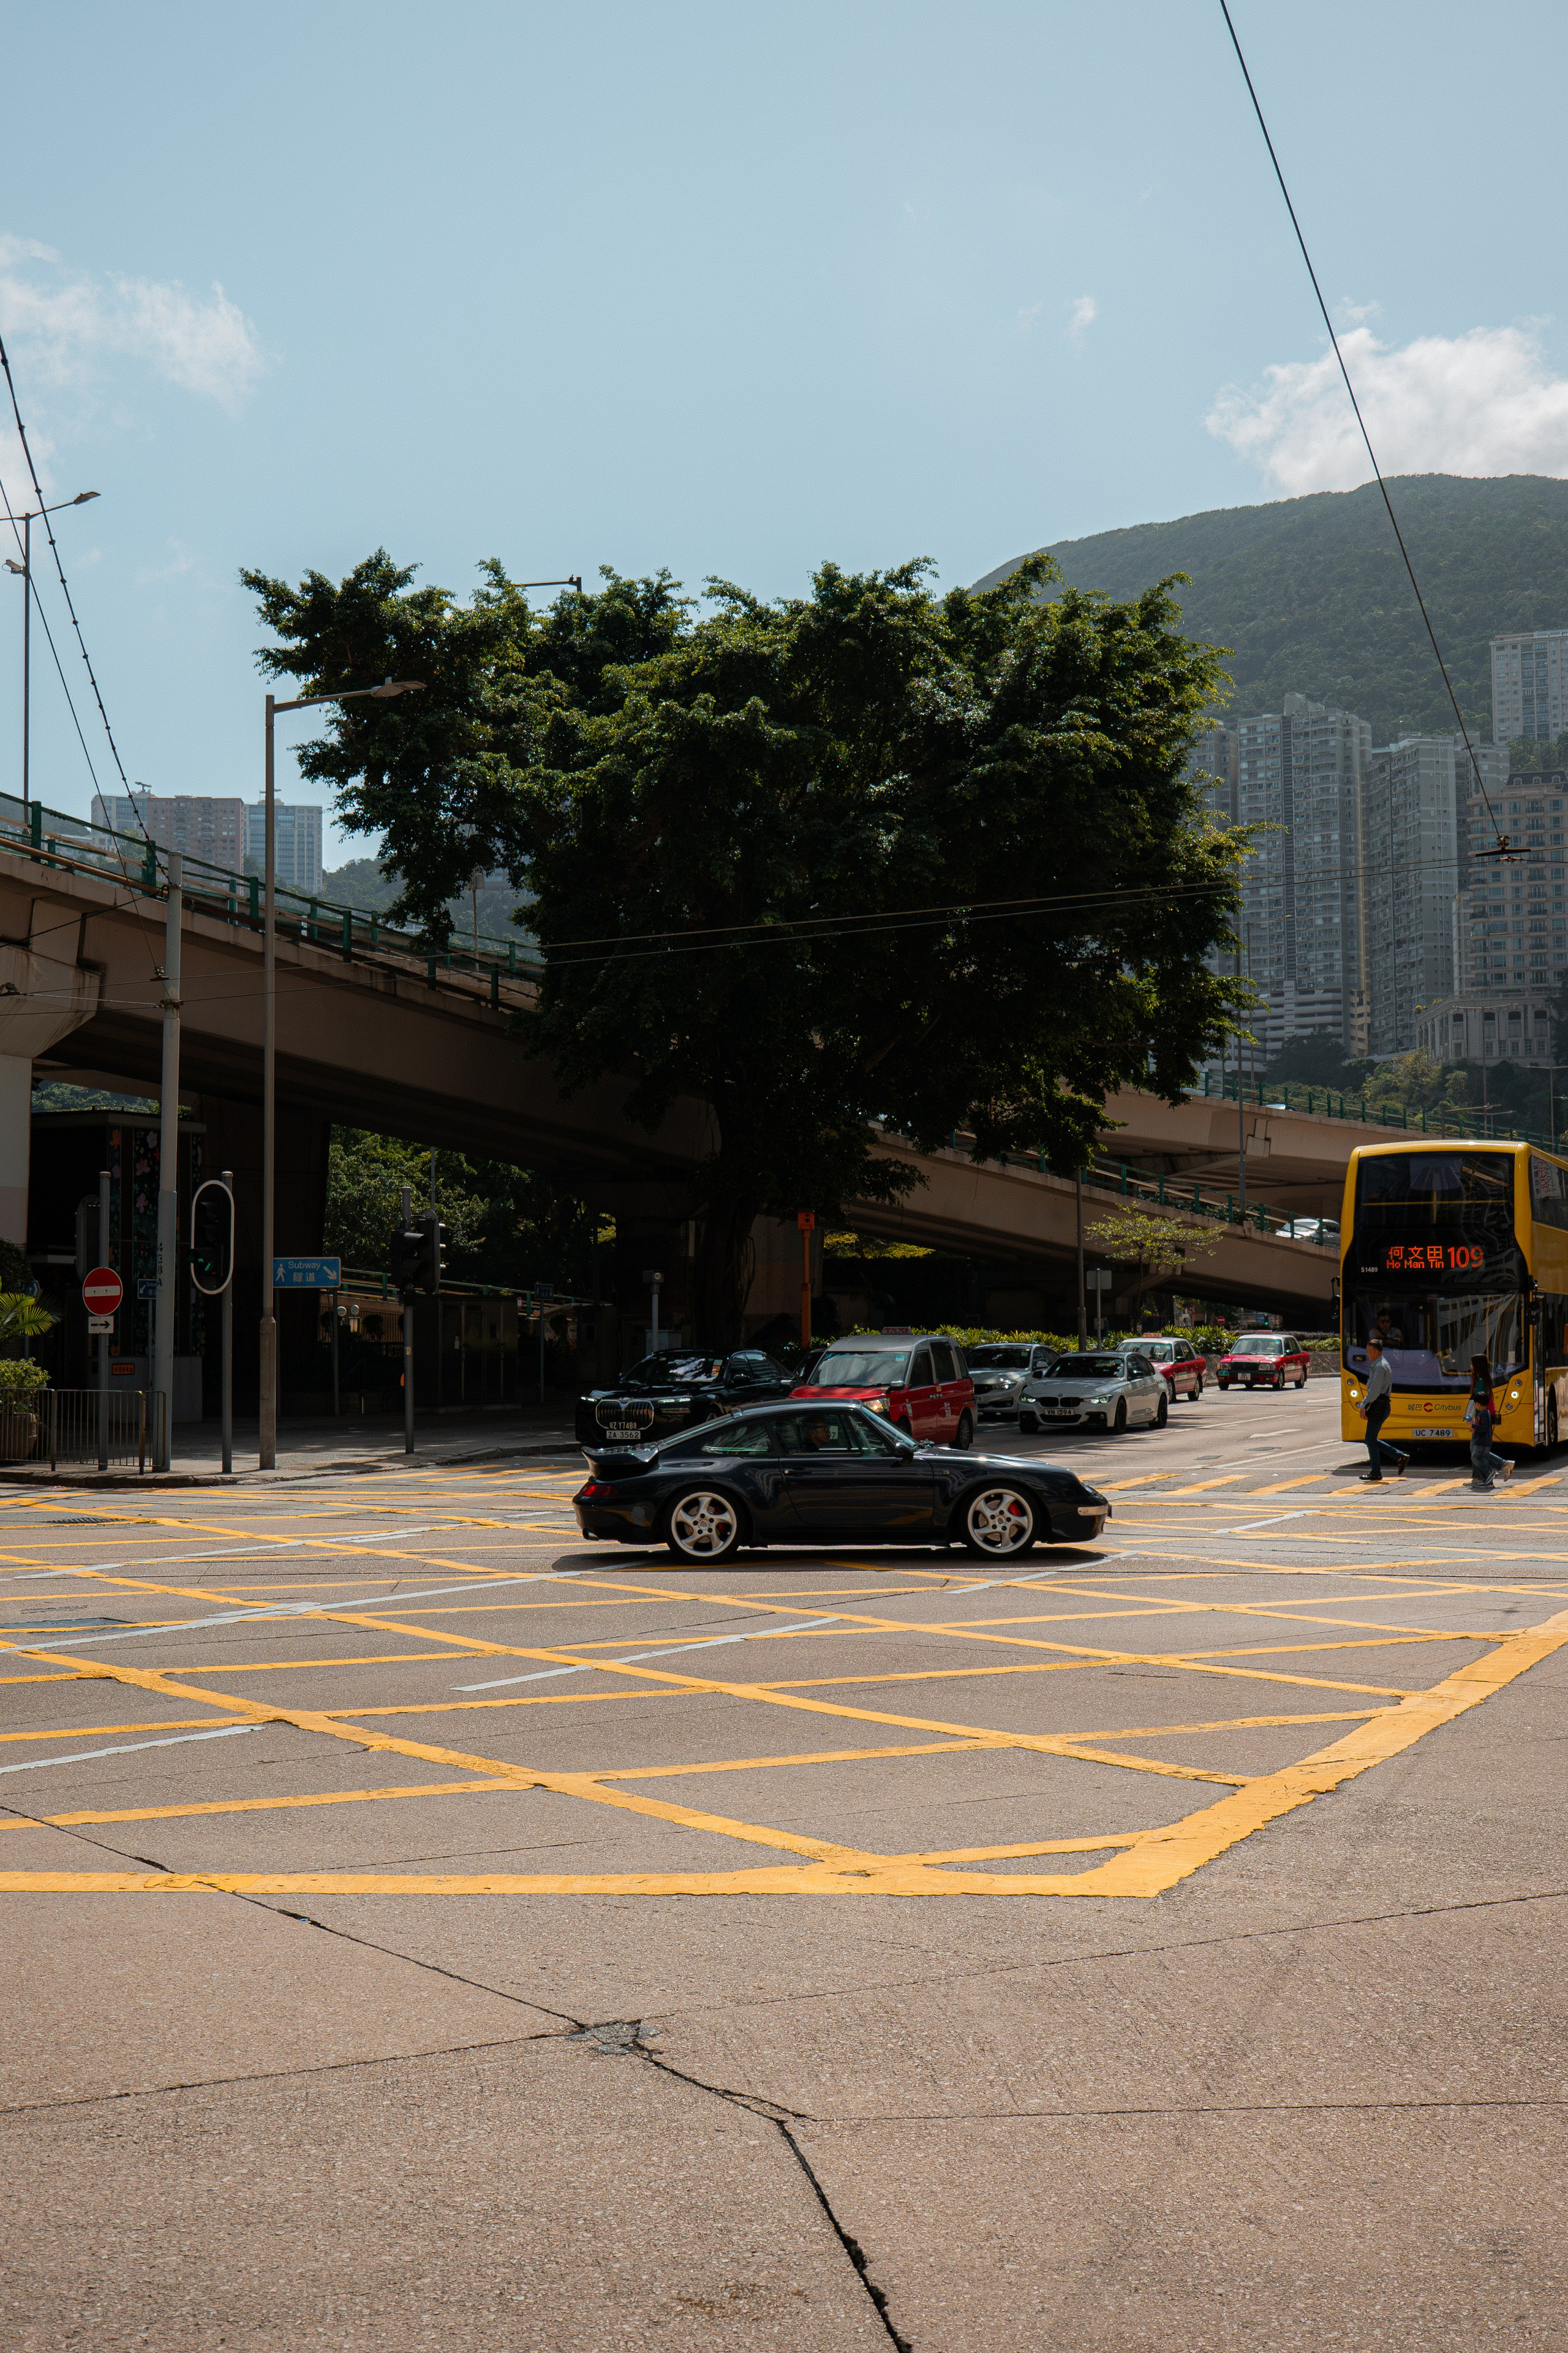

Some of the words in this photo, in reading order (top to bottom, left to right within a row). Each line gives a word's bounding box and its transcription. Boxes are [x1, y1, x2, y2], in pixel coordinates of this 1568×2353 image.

[1388, 1246, 1442, 1260] 何文田
[1447, 1246, 1483, 1268] 109
[288, 1261, 321, 1271] Subway
[1386, 1260, 1401, 1269] Ho
[1404, 1260, 1425, 1269] Man
[1428, 1260, 1444, 1269] Tin
[293, 1272, 316, 1282] 隧道
